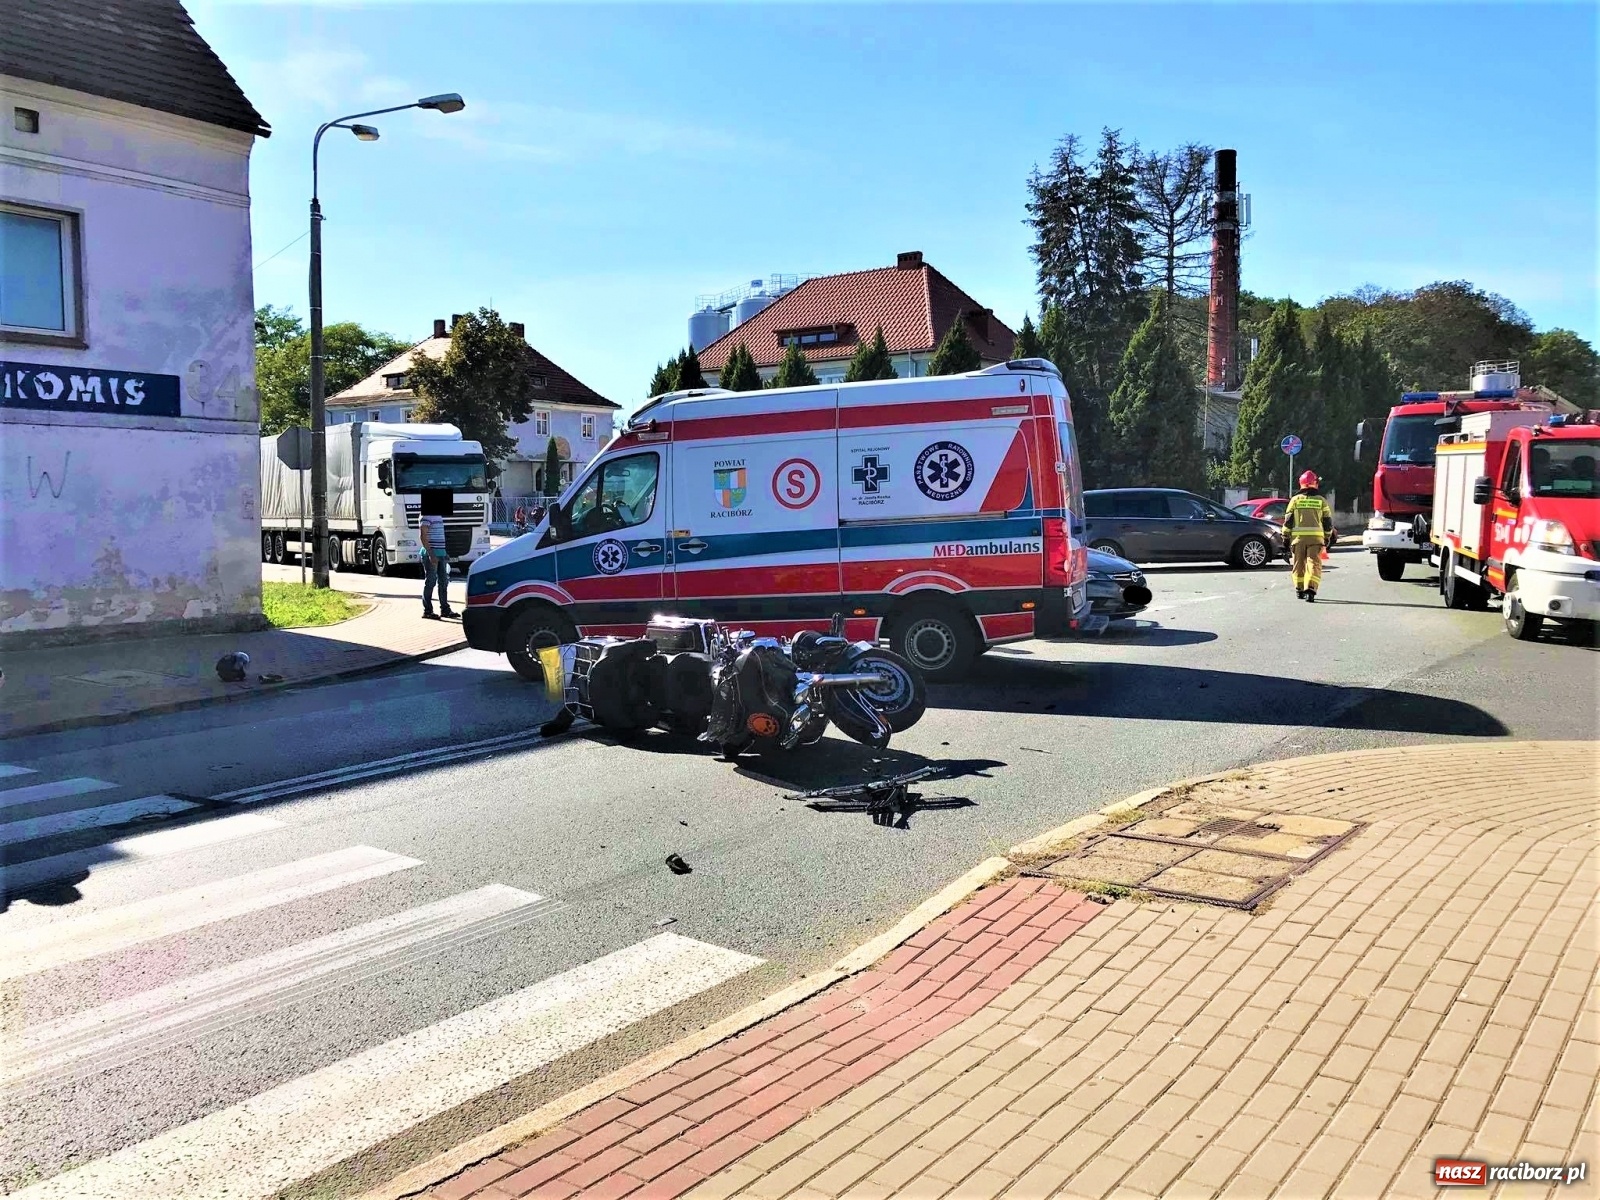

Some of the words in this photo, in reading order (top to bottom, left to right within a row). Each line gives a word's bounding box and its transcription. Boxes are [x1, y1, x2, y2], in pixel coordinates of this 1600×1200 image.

[4, 370, 146, 406] KOMIS
[714, 459, 746, 468] POWIAT
[786, 469, 806, 499] S
[710, 509, 753, 519] RACIBÓRZ
[933, 541, 1040, 557] MEDambulans
